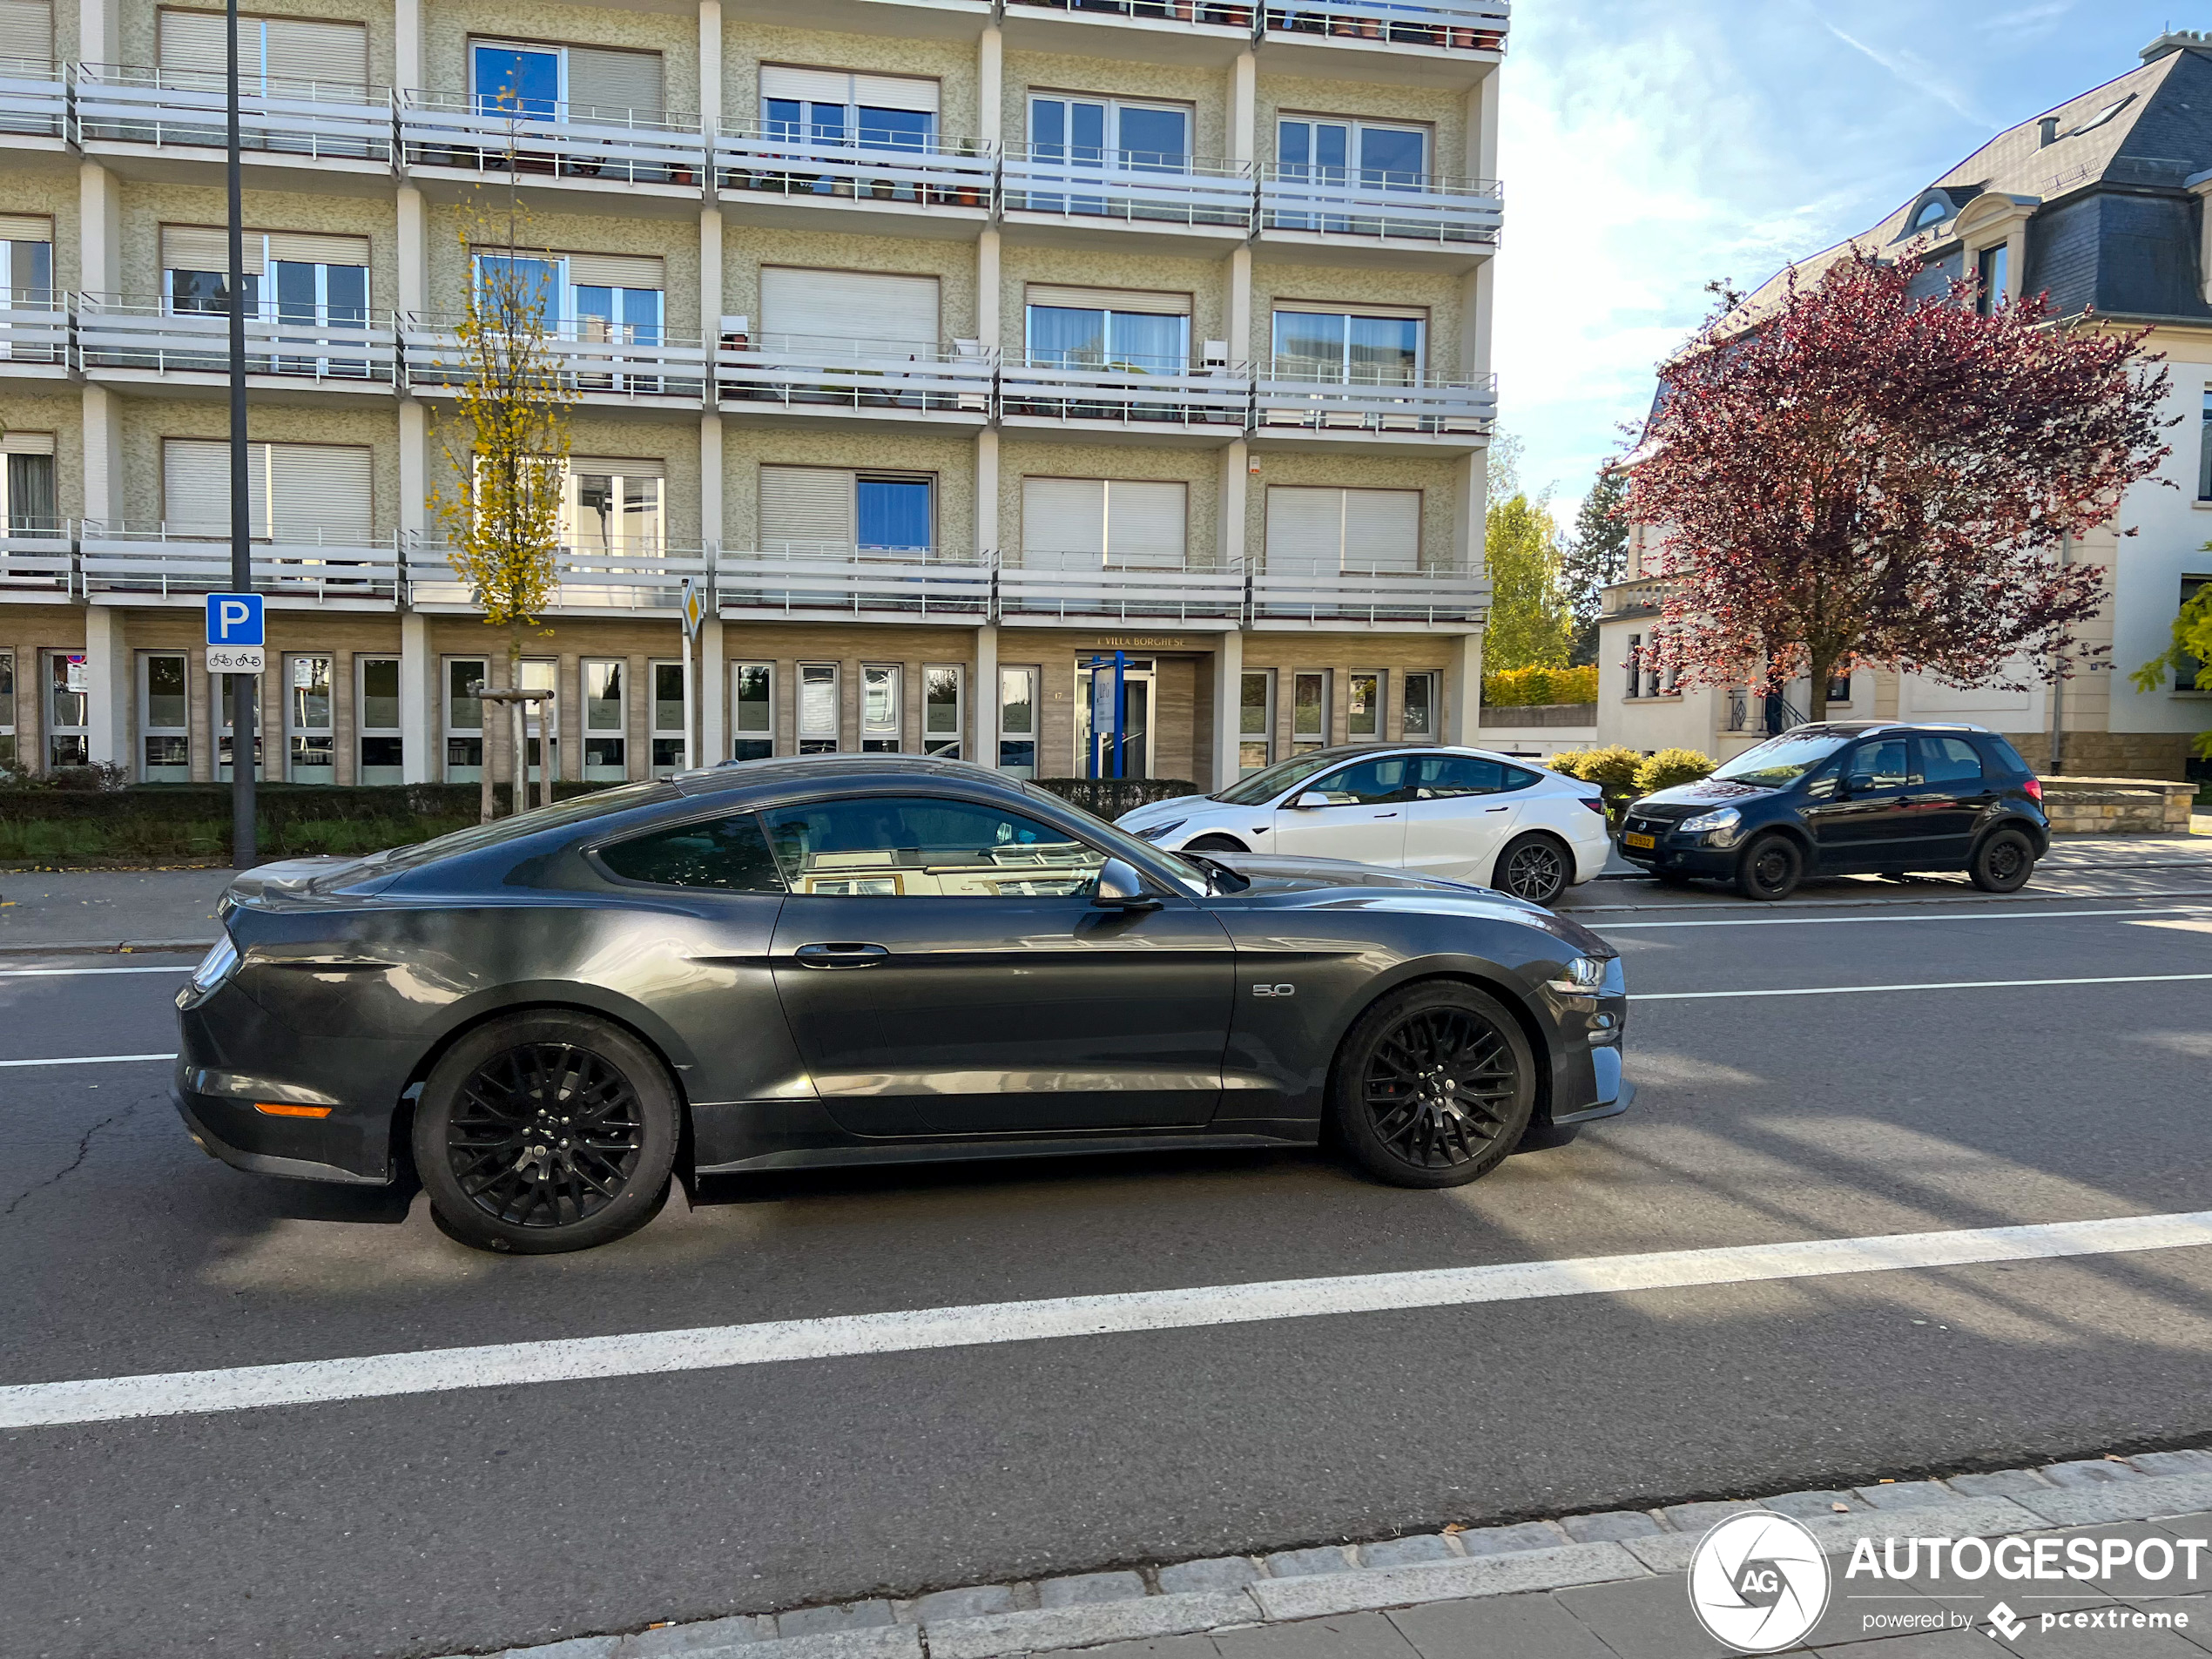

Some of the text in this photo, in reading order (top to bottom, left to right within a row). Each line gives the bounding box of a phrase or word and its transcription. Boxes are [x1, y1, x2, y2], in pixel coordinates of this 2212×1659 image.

[220, 601, 249, 639] P
[1105, 637, 1130, 645] VILLA
[1134, 637, 1185, 646] BORGHESE
[1055, 691, 1062, 700] 17
[1252, 983, 1296, 997] 5.0
